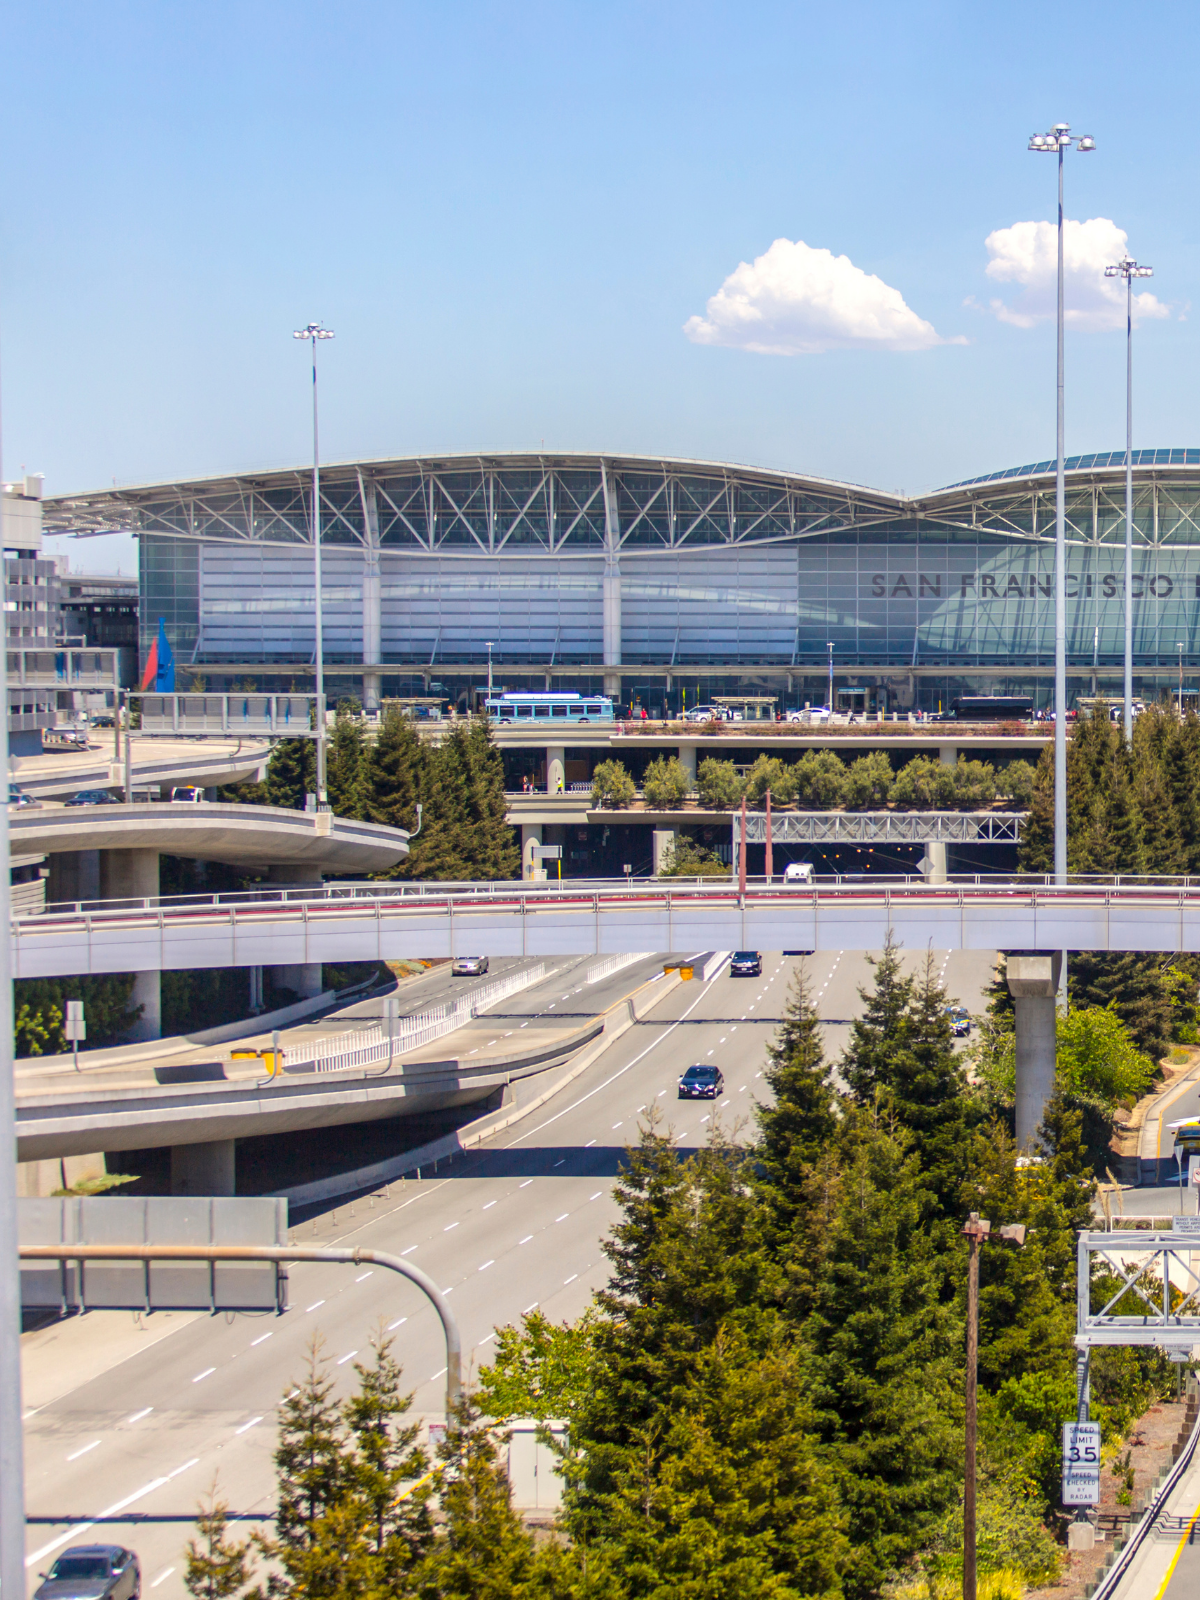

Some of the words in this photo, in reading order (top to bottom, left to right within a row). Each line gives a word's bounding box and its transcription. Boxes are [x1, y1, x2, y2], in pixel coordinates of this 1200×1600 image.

[871, 574, 941, 598] SAN
[961, 574, 1173, 598] FRANCISCO
[1069, 1426, 1095, 1434] SPEED
[1070, 1436, 1094, 1444] LIMIT
[1068, 1446, 1097, 1463] 35
